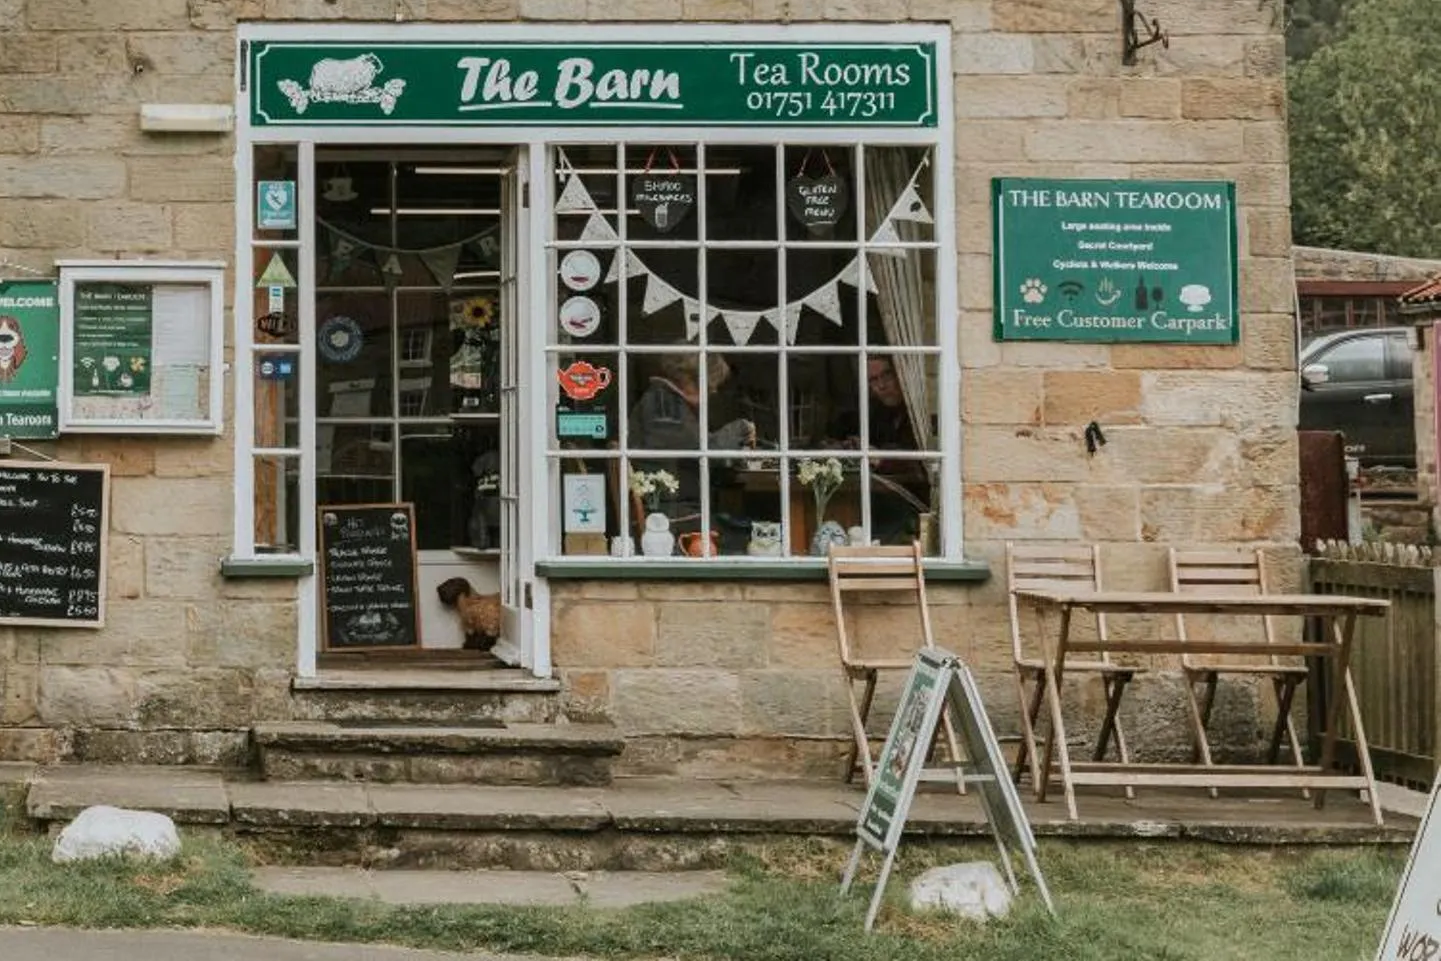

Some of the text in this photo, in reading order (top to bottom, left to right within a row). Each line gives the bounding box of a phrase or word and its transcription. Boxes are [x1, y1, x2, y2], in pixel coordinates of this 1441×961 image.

[730, 52, 910, 85] Tea Rooms
[457, 57, 680, 108] The Barn
[747, 91, 895, 116] 01751 417311
[1009, 190, 1221, 209] THE BARN TEAROOM
[1061, 221, 1087, 232] Large
[1108, 241, 1154, 251] Courtyard
[1013, 309, 1227, 334] Free Customer Carpark
